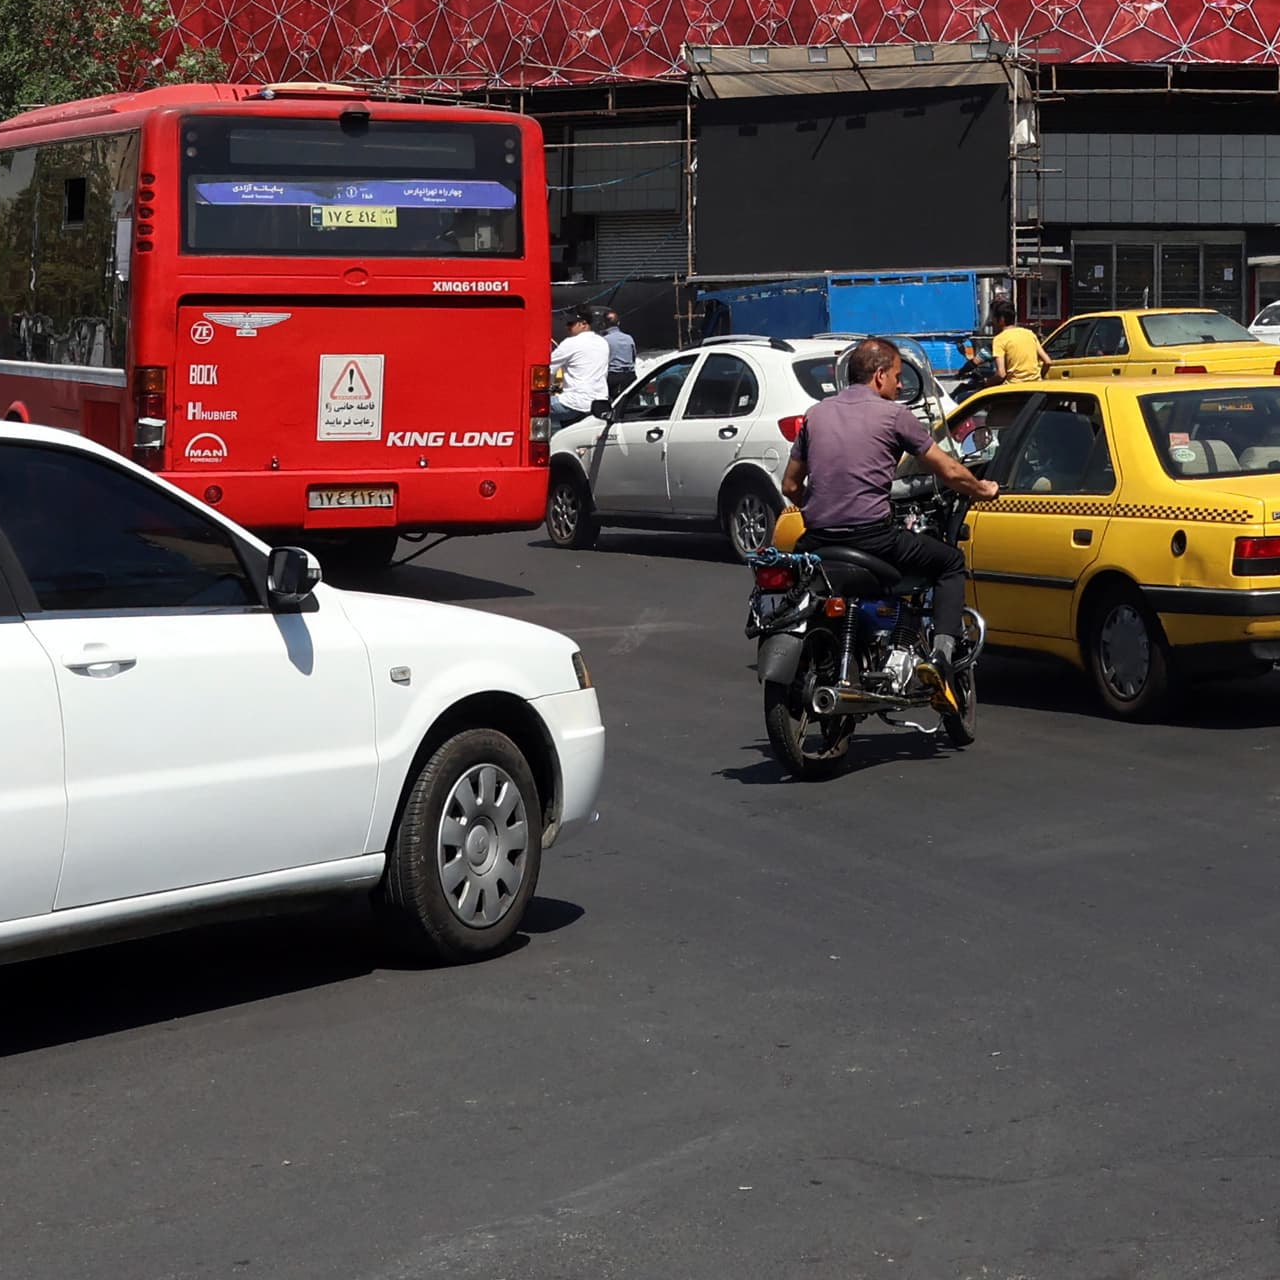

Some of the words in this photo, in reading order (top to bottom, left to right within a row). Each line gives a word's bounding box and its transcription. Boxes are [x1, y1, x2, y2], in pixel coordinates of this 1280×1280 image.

[232, 183, 252, 193] آزادی
[252, 184, 284, 195] پایانه
[432, 281, 509, 292] XMQ6180G1
[193, 325, 212, 340] ZF
[189, 365, 218, 385] BOCK
[325, 402, 332, 413] را
[333, 402, 354, 413] جانبی
[357, 401, 375, 410] فاصله
[353, 417, 374, 428] رعایت
[386, 432, 445, 447] KING
[449, 432, 514, 447] LONG
[189, 449, 223, 457] MAN
